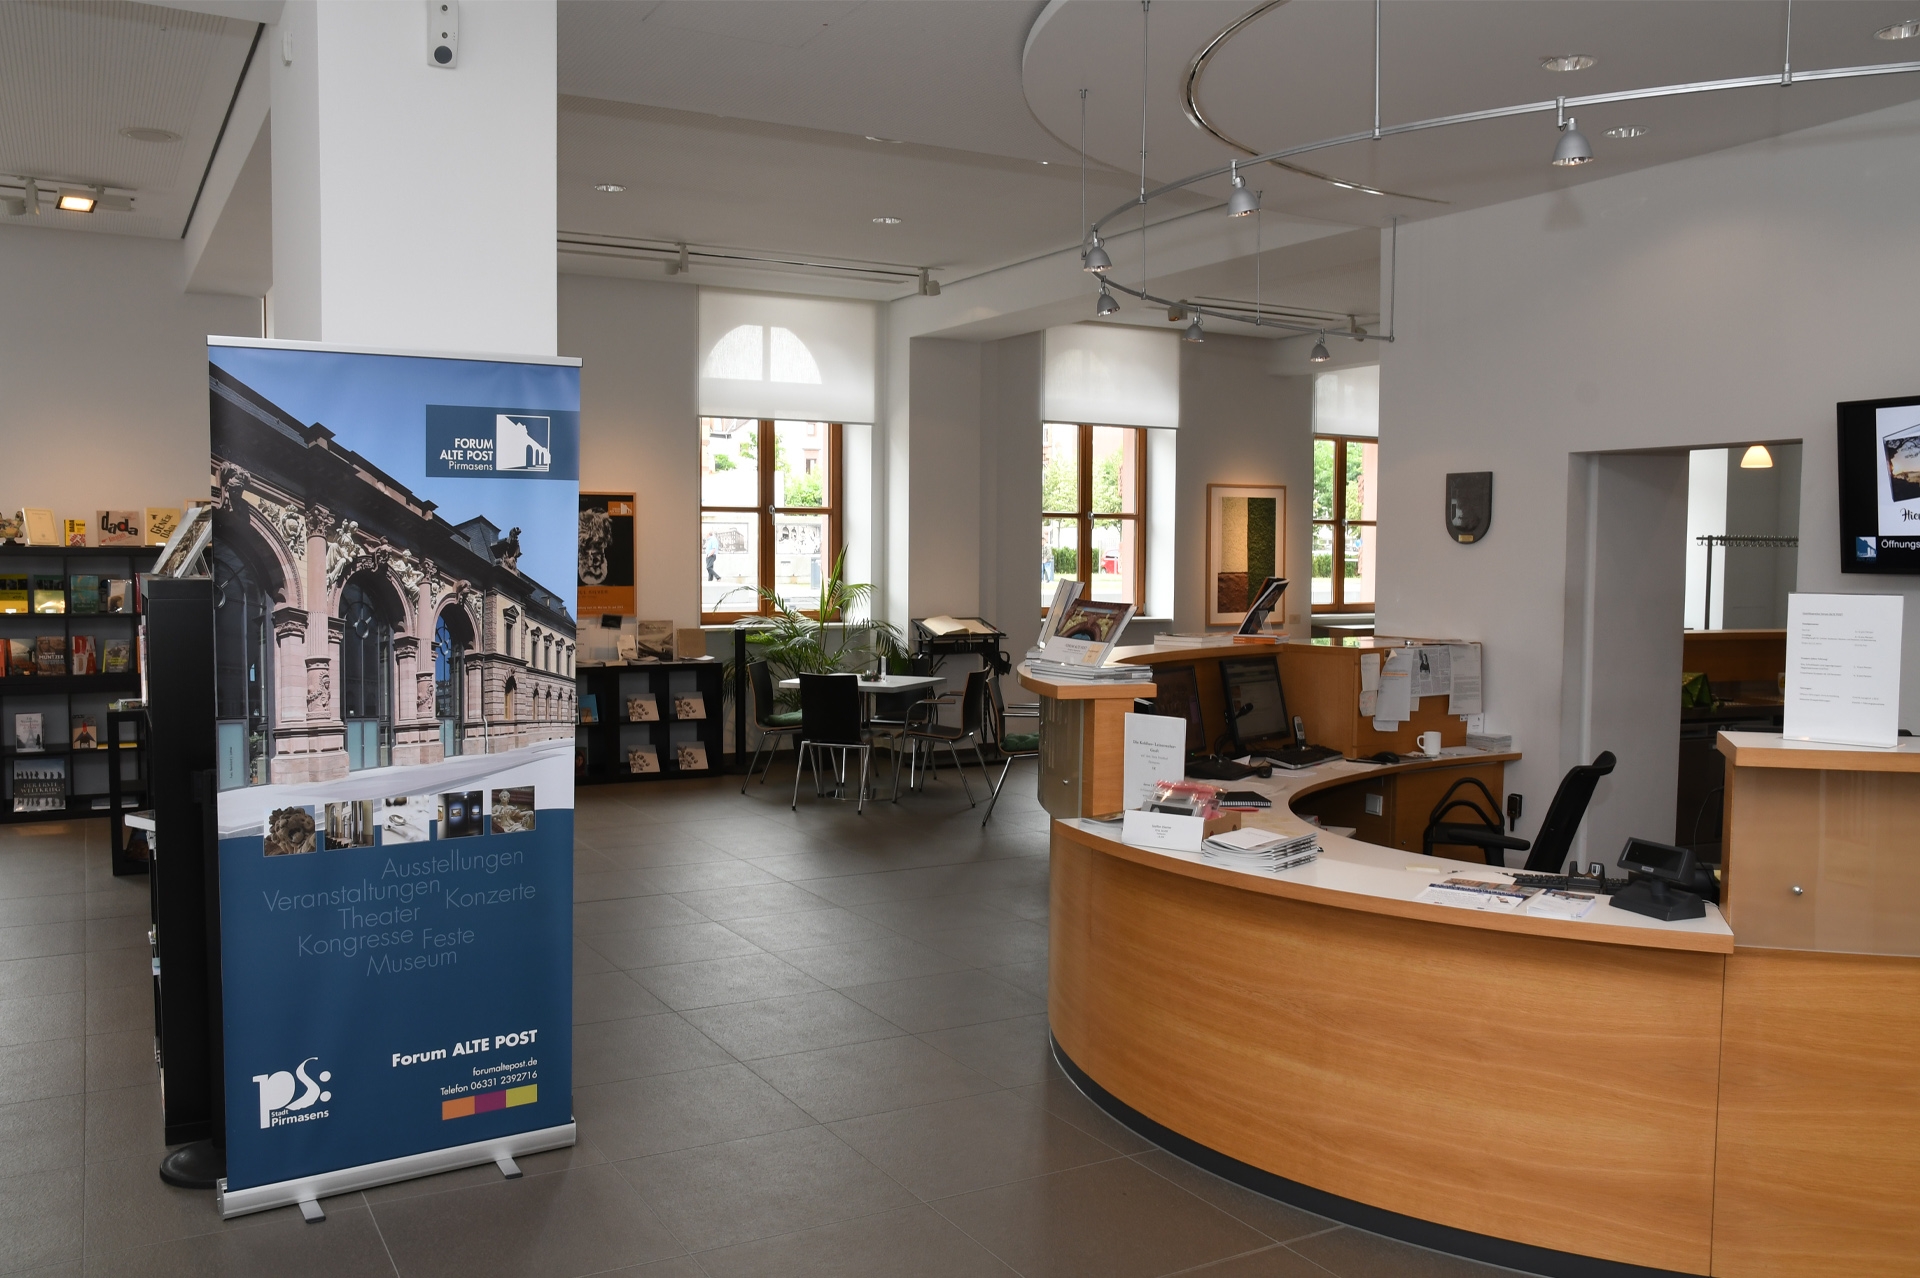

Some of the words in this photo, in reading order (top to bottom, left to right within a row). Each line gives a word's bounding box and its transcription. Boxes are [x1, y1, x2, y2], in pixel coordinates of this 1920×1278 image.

[440, 450, 463, 460] ALTE
[467, 450, 493, 461] POST
[455, 438, 493, 449] FORUM
[449, 461, 493, 471] Pirmasens
[102, 511, 138, 536] dada
[381, 849, 523, 880] Ausstellungen
[262, 878, 440, 912] Veranstaltungen
[446, 883, 536, 909] Konzerte
[337, 905, 421, 930] Theater
[298, 929, 414, 958] Kongresse
[423, 927, 475, 949] Feste
[366, 950, 457, 976] Museum
[392, 1047, 447, 1068] Forum
[452, 1037, 490, 1057] ALTE
[495, 1029, 538, 1049] POST
[472, 1057, 538, 1077] forumaltepost.de
[440, 1083, 469, 1096] Telefon
[470, 1077, 498, 1091] 06331
[500, 1070, 538, 1085] 2392716
[271, 1109, 289, 1118] Stadt
[271, 1110, 330, 1127] Pirmasens
